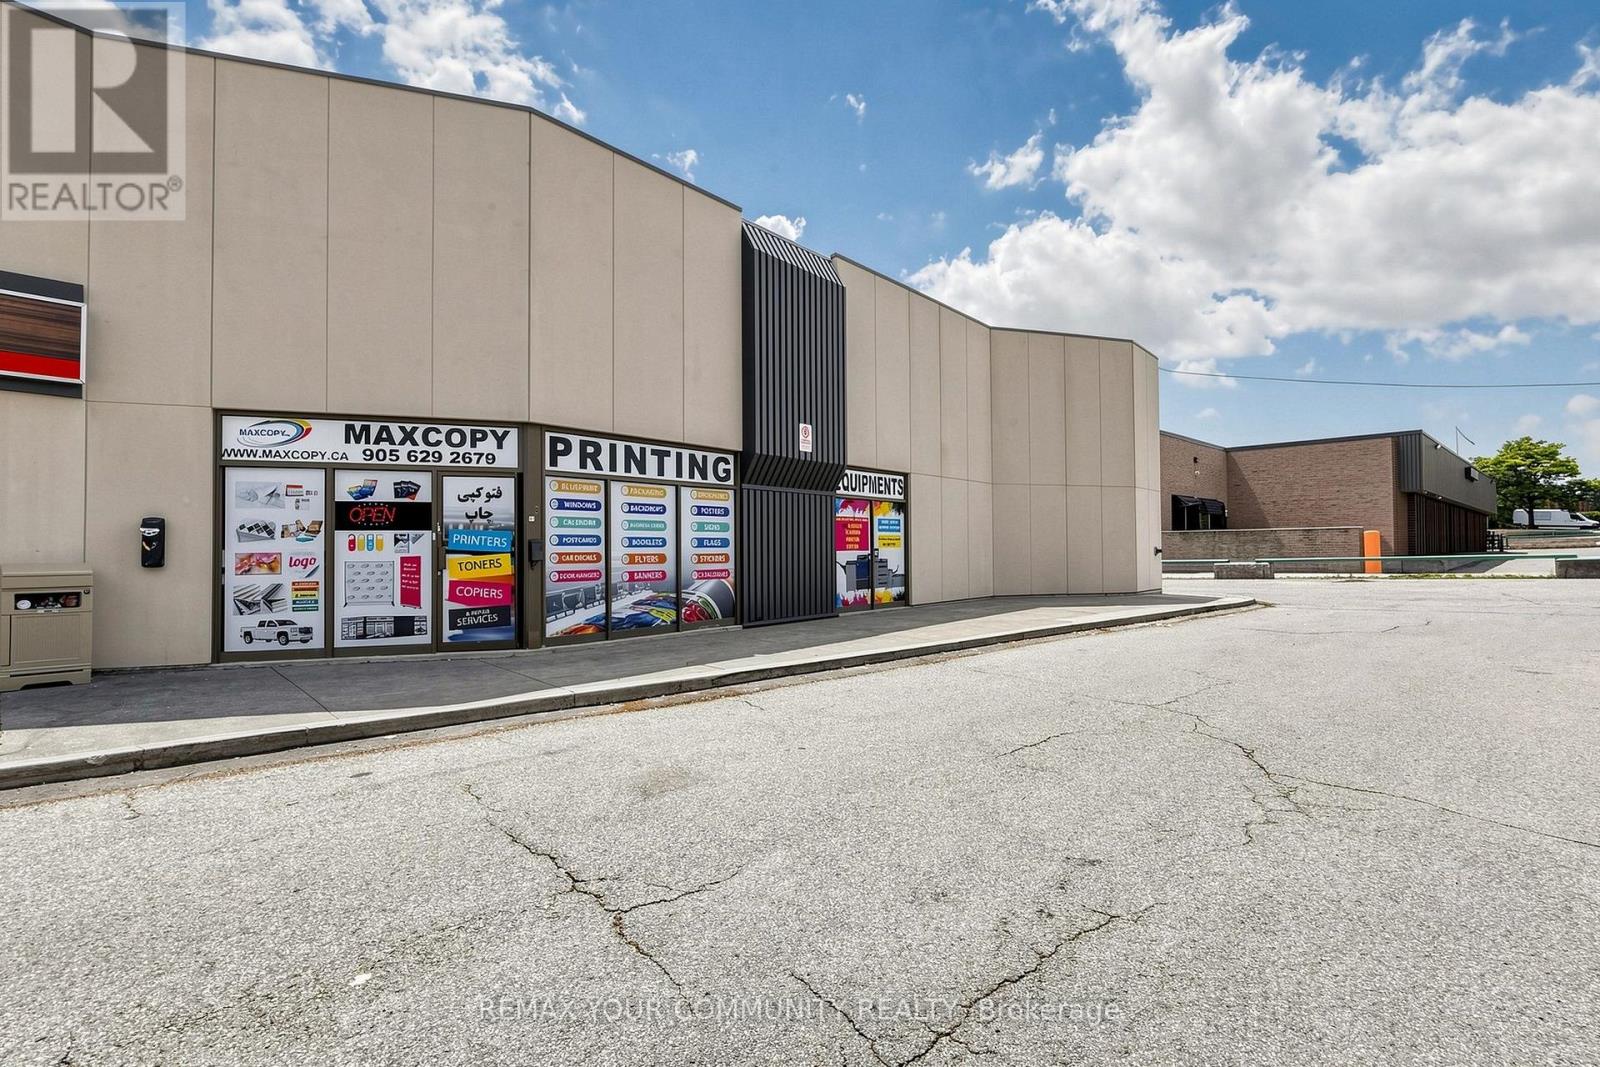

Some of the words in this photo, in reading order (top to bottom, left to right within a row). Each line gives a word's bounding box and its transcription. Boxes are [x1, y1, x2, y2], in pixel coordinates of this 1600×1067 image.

[239, 428, 287, 437] MAXCOPY
[345, 423, 511, 450] MAXCOPY
[221, 448, 349, 461] WWW.MAXCOPY.CA
[362, 448, 400, 462] 905
[406, 449, 443, 463] 629
[449, 451, 497, 465] 2679
[549, 435, 732, 483] PRINTING
[563, 501, 597, 509] WINDOWS
[630, 505, 663, 513] BACKDROPS
[700, 507, 725, 515] POSTERS
[349, 507, 396, 522] OPEN
[464, 507, 494, 524] چاپ
[453, 533, 508, 548] PRINTERS
[457, 557, 503, 572] TONERS
[561, 554, 574, 562] CAR
[574, 554, 597, 562] DECALS
[634, 555, 659, 563] FLYERS
[633, 571, 663, 579] BANNERS
[455, 586, 503, 600] COPIERS
[456, 613, 499, 627] SERVICES
